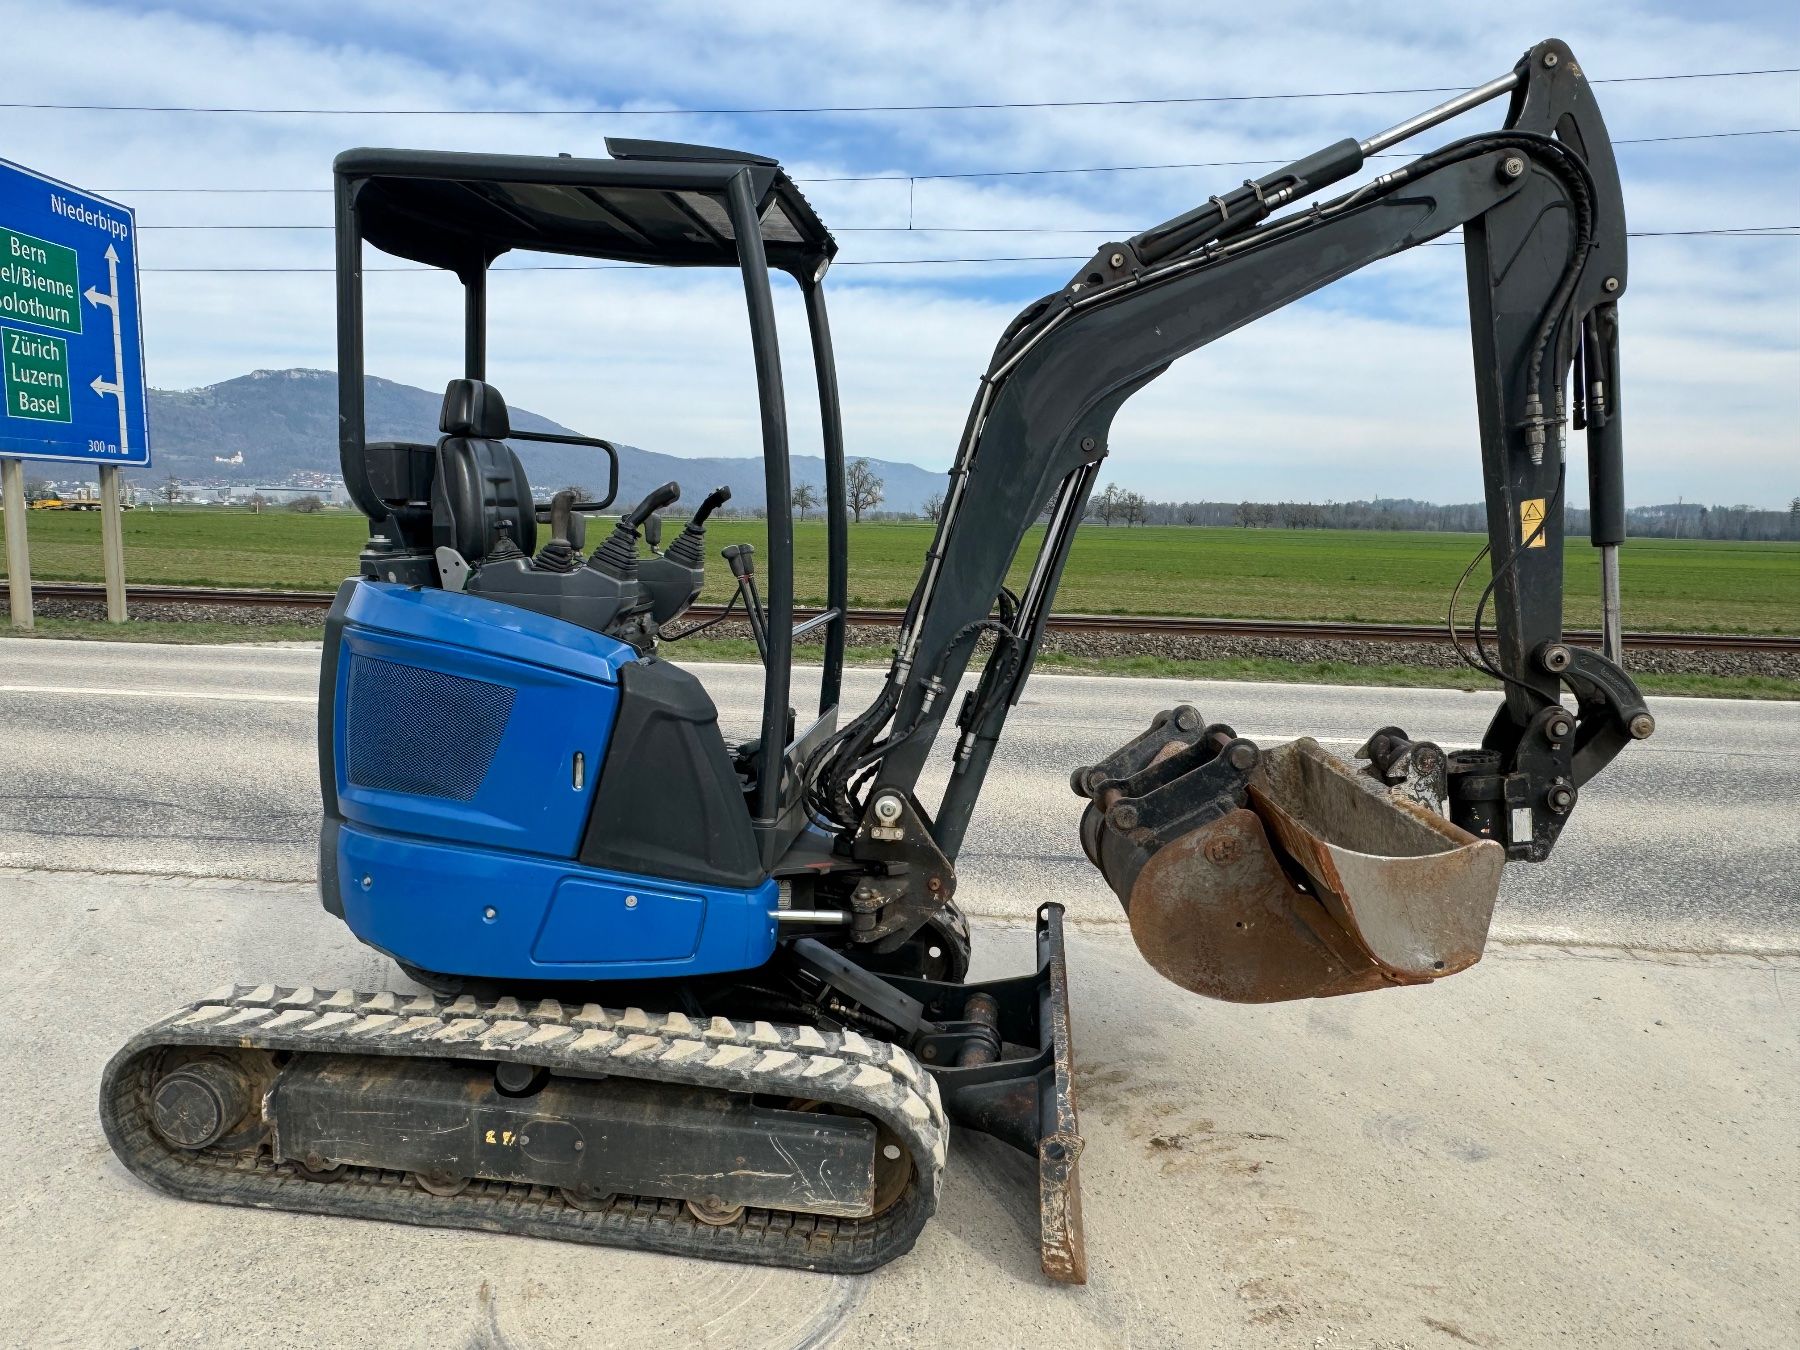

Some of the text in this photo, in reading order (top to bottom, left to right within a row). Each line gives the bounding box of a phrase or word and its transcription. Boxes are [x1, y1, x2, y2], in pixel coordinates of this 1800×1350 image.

[50, 193, 128, 241] Niederbipp
[10, 235, 47, 264] Bern
[0, 291, 70, 324] olothurn
[10, 334, 60, 360] Zürich
[11, 362, 63, 388] Luzern
[19, 391, 60, 415] Basel
[88, 439, 117, 454] 300 m
